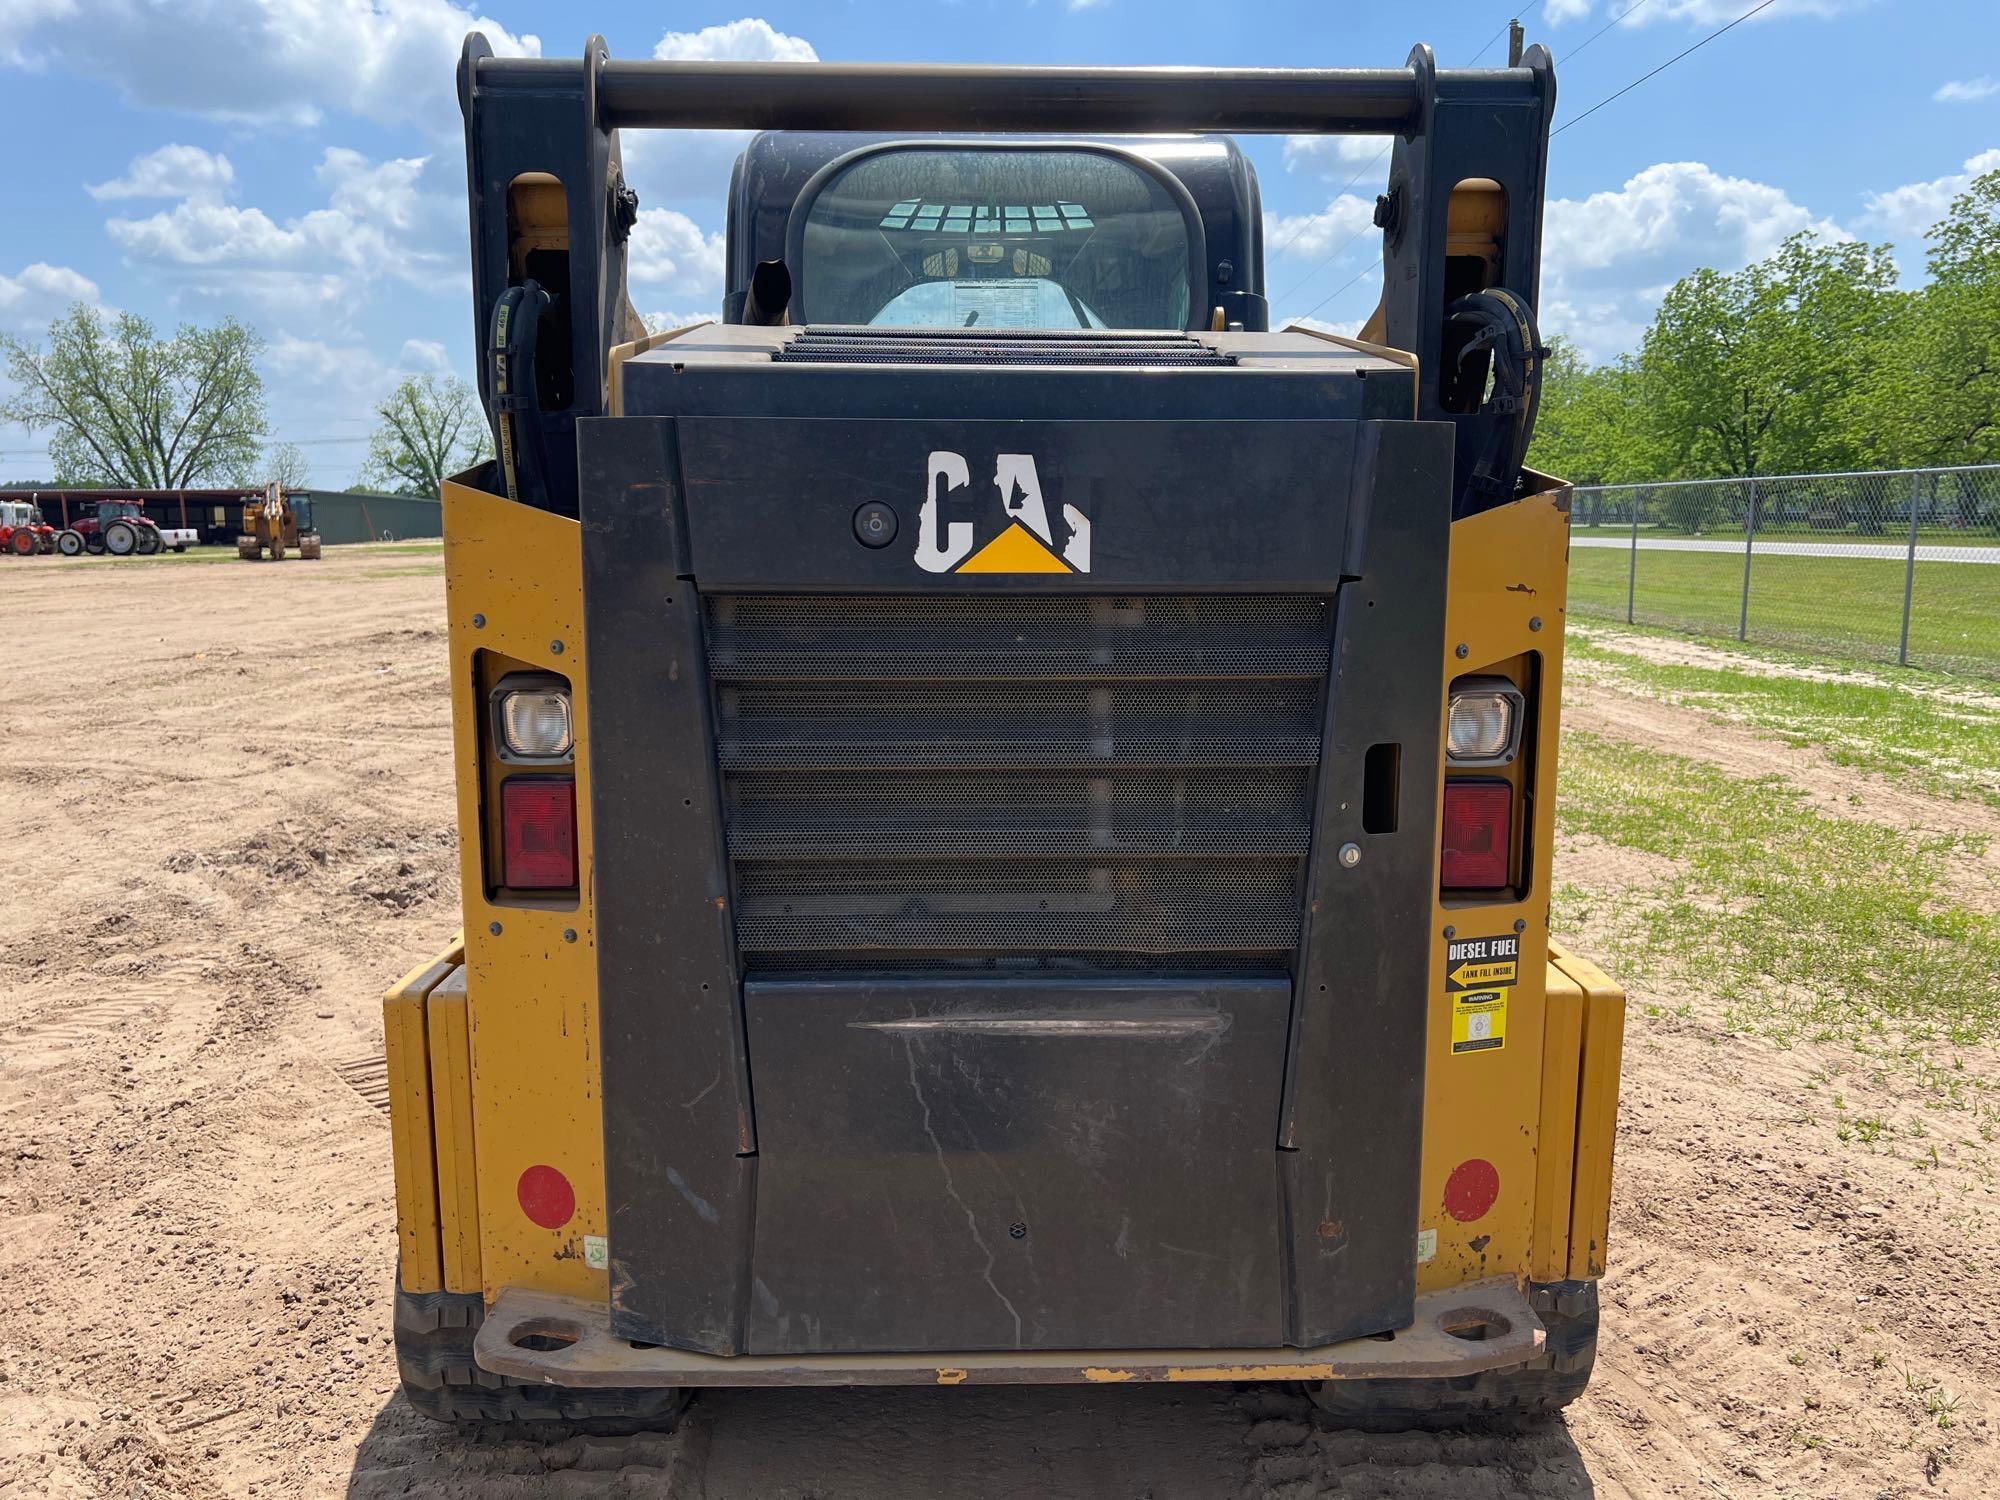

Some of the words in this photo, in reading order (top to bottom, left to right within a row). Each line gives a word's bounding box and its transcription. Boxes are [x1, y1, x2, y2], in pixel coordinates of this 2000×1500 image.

[1449, 941, 1488, 961] DIESEL
[1491, 939, 1518, 956] FUEL
[1462, 969, 1478, 979] TANK
[1479, 968, 1492, 977] FILL
[1493, 966, 1513, 976] INSIDE
[1468, 994, 1493, 1003] WARNING
